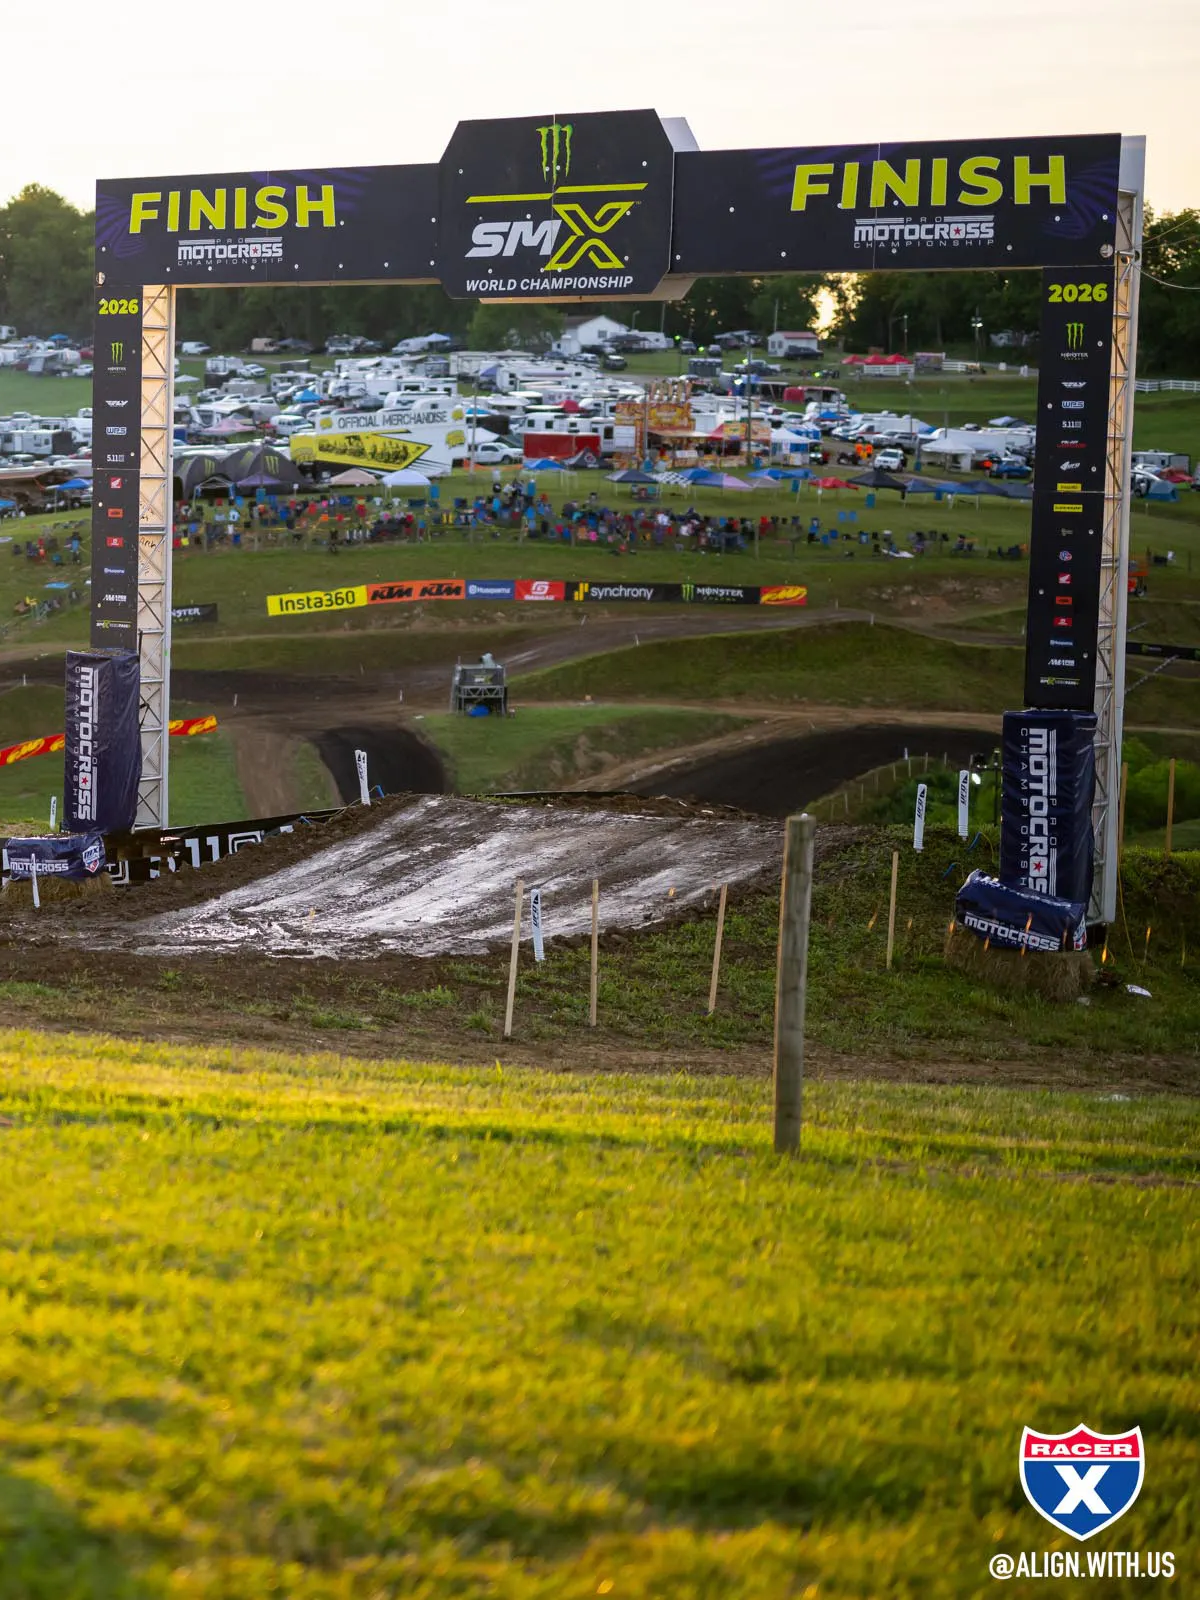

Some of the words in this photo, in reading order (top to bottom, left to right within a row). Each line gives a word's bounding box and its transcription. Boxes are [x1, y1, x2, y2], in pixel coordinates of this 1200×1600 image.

[790, 155, 1066, 212] FINISH
[129, 185, 336, 234] FINISH
[906, 215, 942, 223] PRO
[464, 201, 635, 271] SMX
[854, 222, 994, 242] MOTOCROSS
[177, 242, 283, 260] MOTOCROSS
[854, 239, 994, 249] CHAMPIONSHIP
[177, 257, 283, 266] CHAMPIONSHIP
[466, 278, 517, 292] WORLD
[520, 276, 633, 291] CHAMPIONSHIP
[1048, 283, 1108, 303] 2026
[98, 298, 139, 315] 2026
[337, 414, 380, 429] OFFICIAL
[382, 411, 448, 427] MERCHANDISE
[370, 585, 413, 601] KTM
[420, 583, 464, 598] KTM
[590, 585, 653, 600] synchrony
[696, 587, 744, 598] MONSTER
[279, 590, 355, 612] Insta360
[72, 666, 80, 819] CHAMPIONSHIP
[77, 666, 94, 820] MOTOCROSS
[1020, 727, 1028, 886] CHAMPIONSH
[1028, 727, 1049, 894] MOTOCROS
[964, 915, 1060, 951] MOTOCROSS
